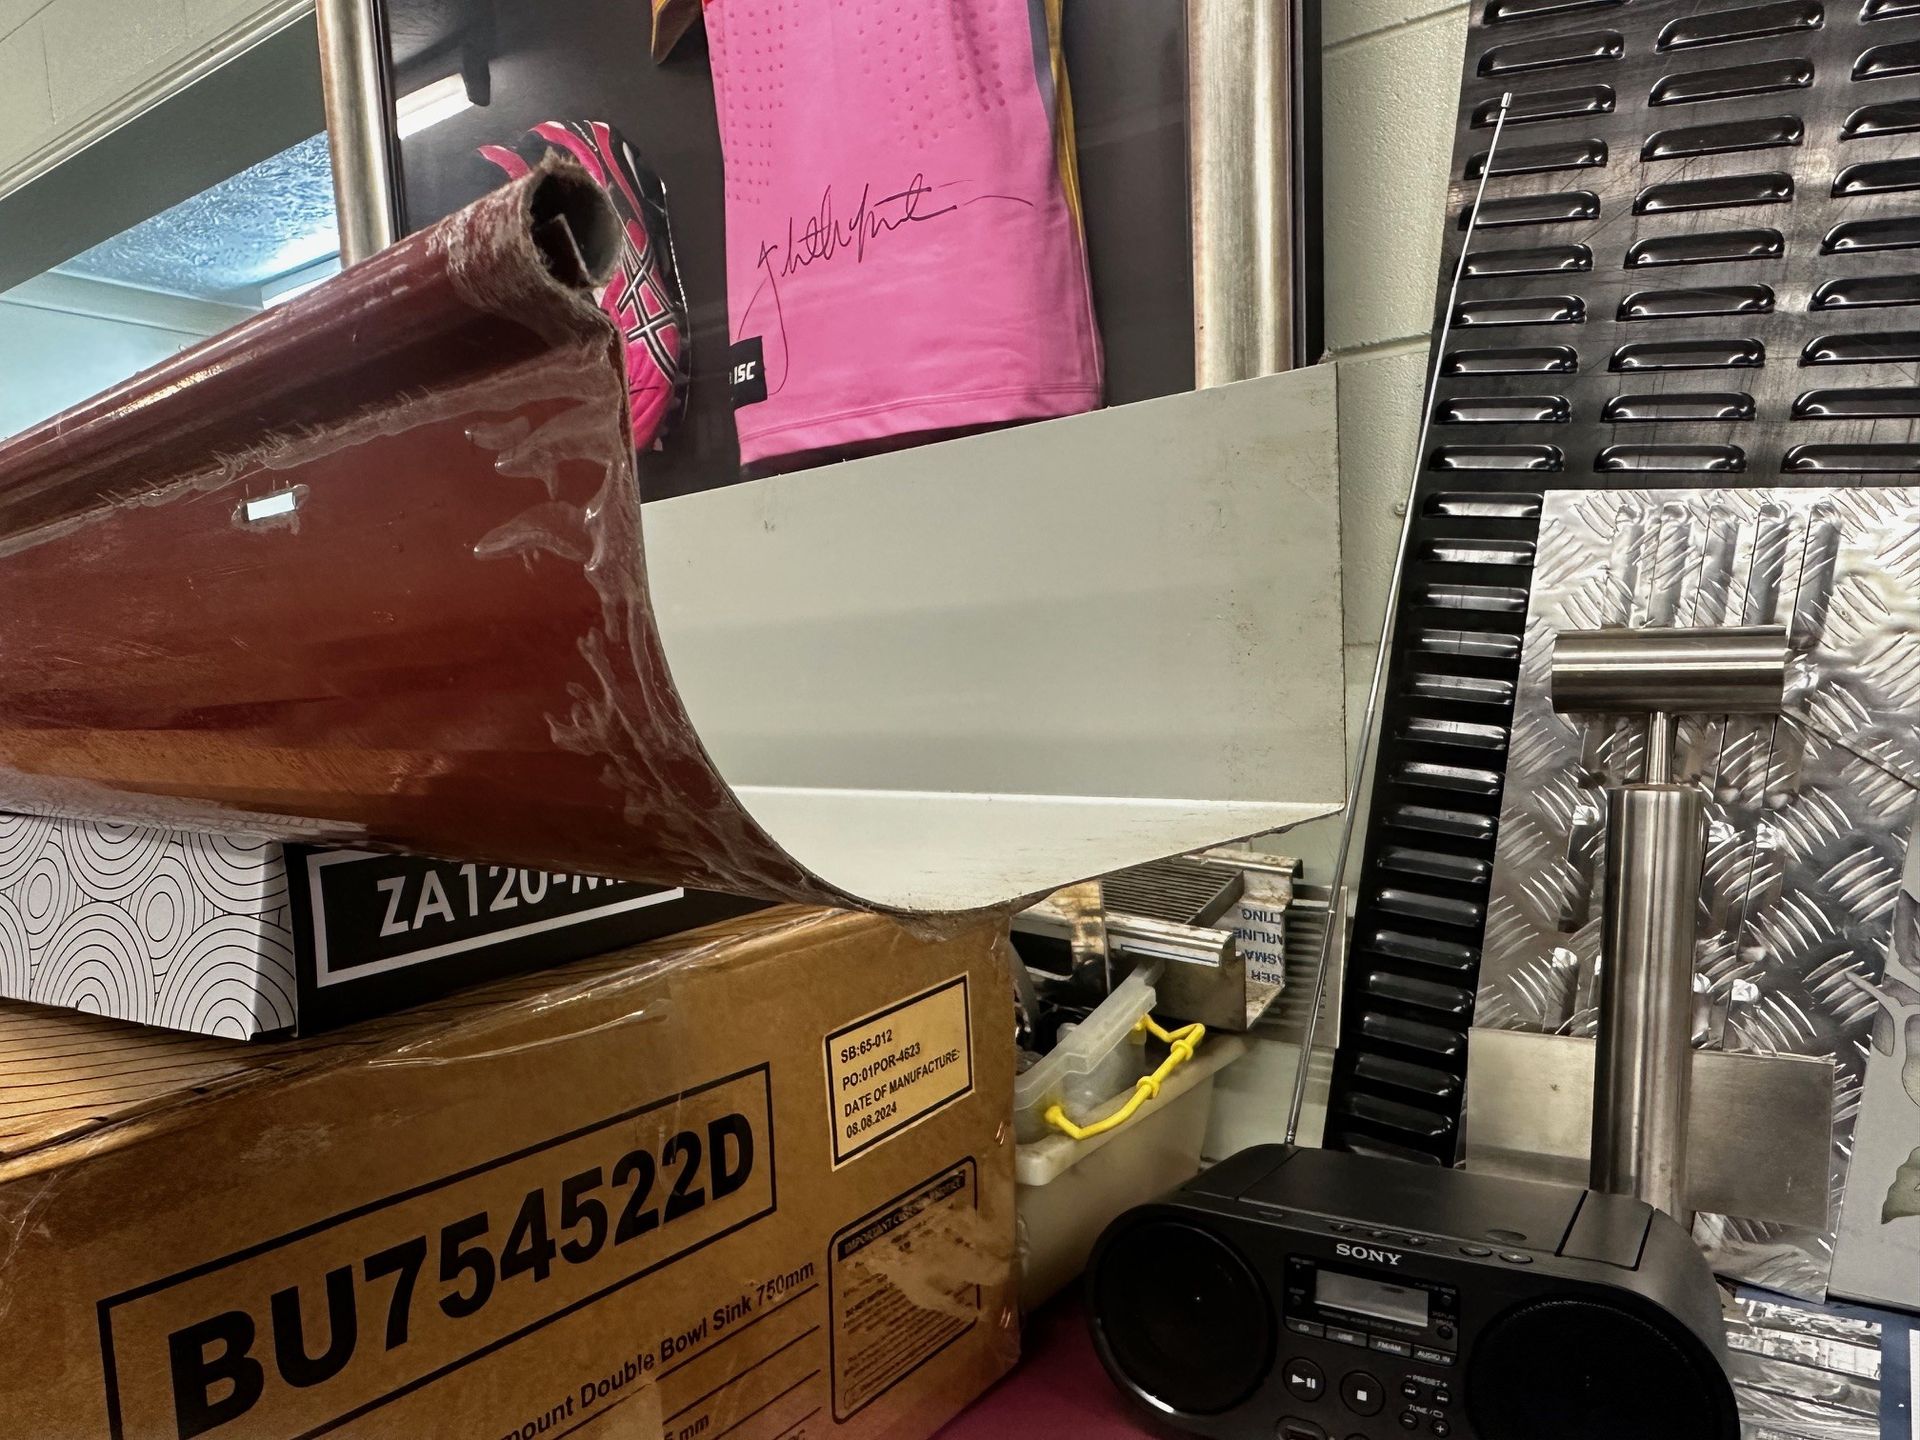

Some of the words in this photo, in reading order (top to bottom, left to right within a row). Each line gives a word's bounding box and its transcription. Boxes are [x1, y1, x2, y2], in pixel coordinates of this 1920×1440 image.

[733, 360, 757, 385] ISC
[840, 1028, 894, 1064] SB:65-012
[842, 1042, 922, 1091] PO:01POR-4623
[844, 1092, 872, 1118] DATE
[874, 1084, 888, 1102] OF
[846, 1101, 898, 1139] 08.08.2024
[1335, 1243, 1403, 1266] SONY
[168, 1112, 754, 1439] BU754522D
[580, 1351, 656, 1410] Double
[659, 1316, 709, 1363] Bowl
[711, 1292, 753, 1333] Sink
[755, 1261, 815, 1306] 750mm
